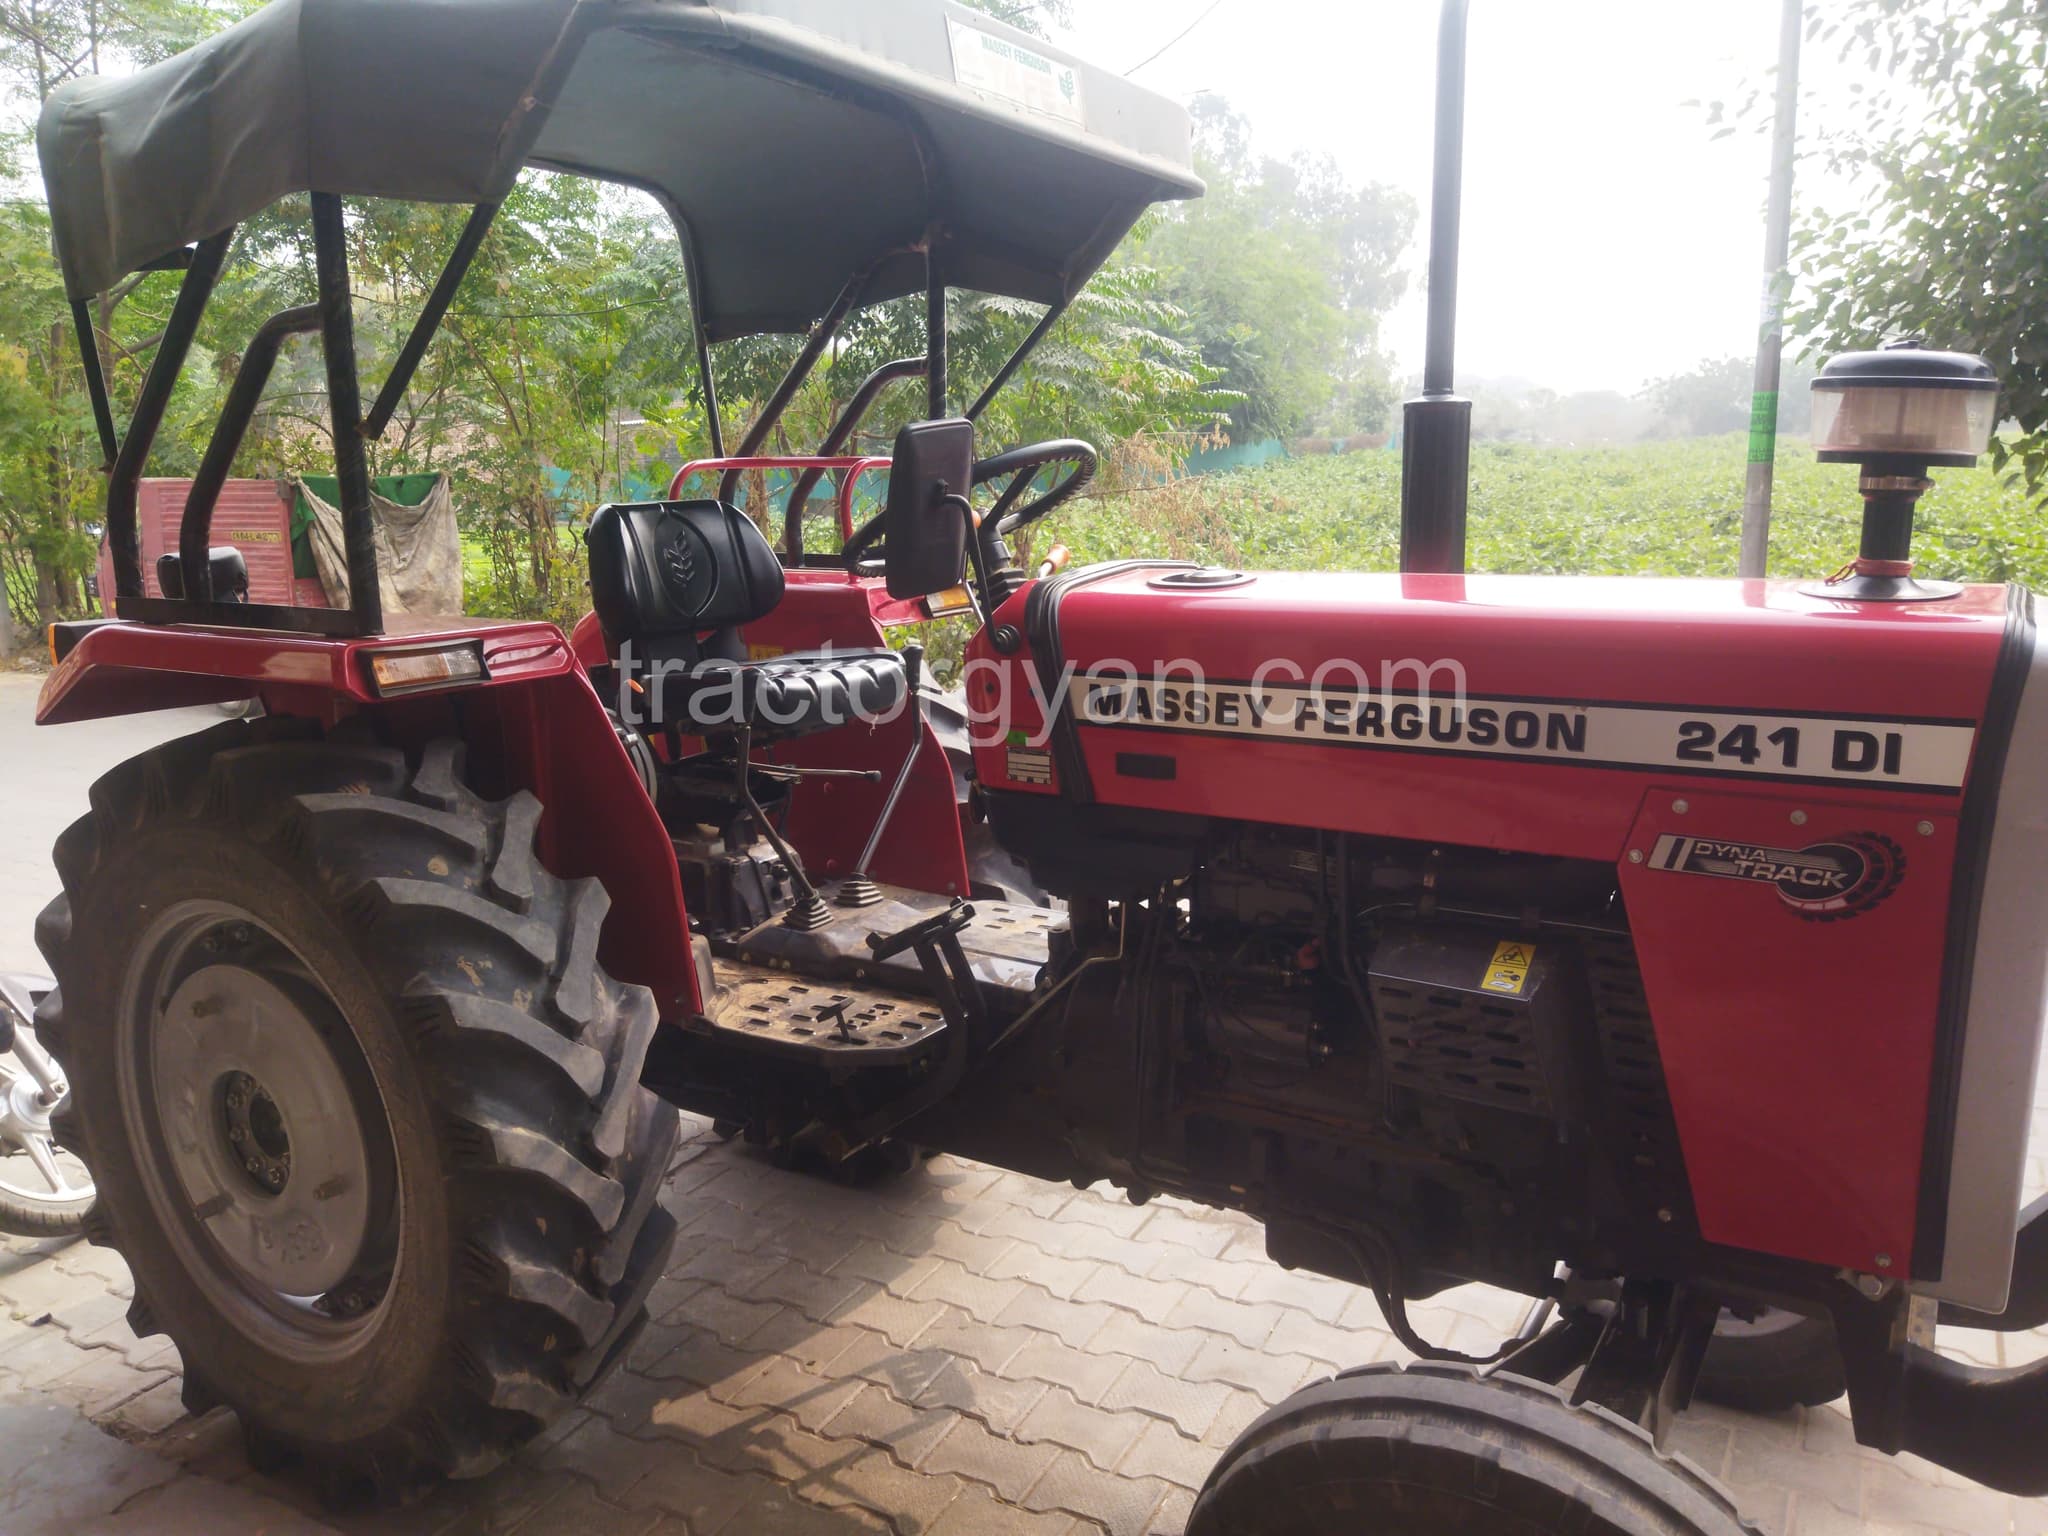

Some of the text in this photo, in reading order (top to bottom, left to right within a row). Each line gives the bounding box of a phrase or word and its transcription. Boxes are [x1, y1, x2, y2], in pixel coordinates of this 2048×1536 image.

[1088, 683, 1903, 775] MASSEY FERGUSON 241 DI
[1694, 842, 1769, 863] DYNA
[1732, 860, 1849, 889] TRACK
